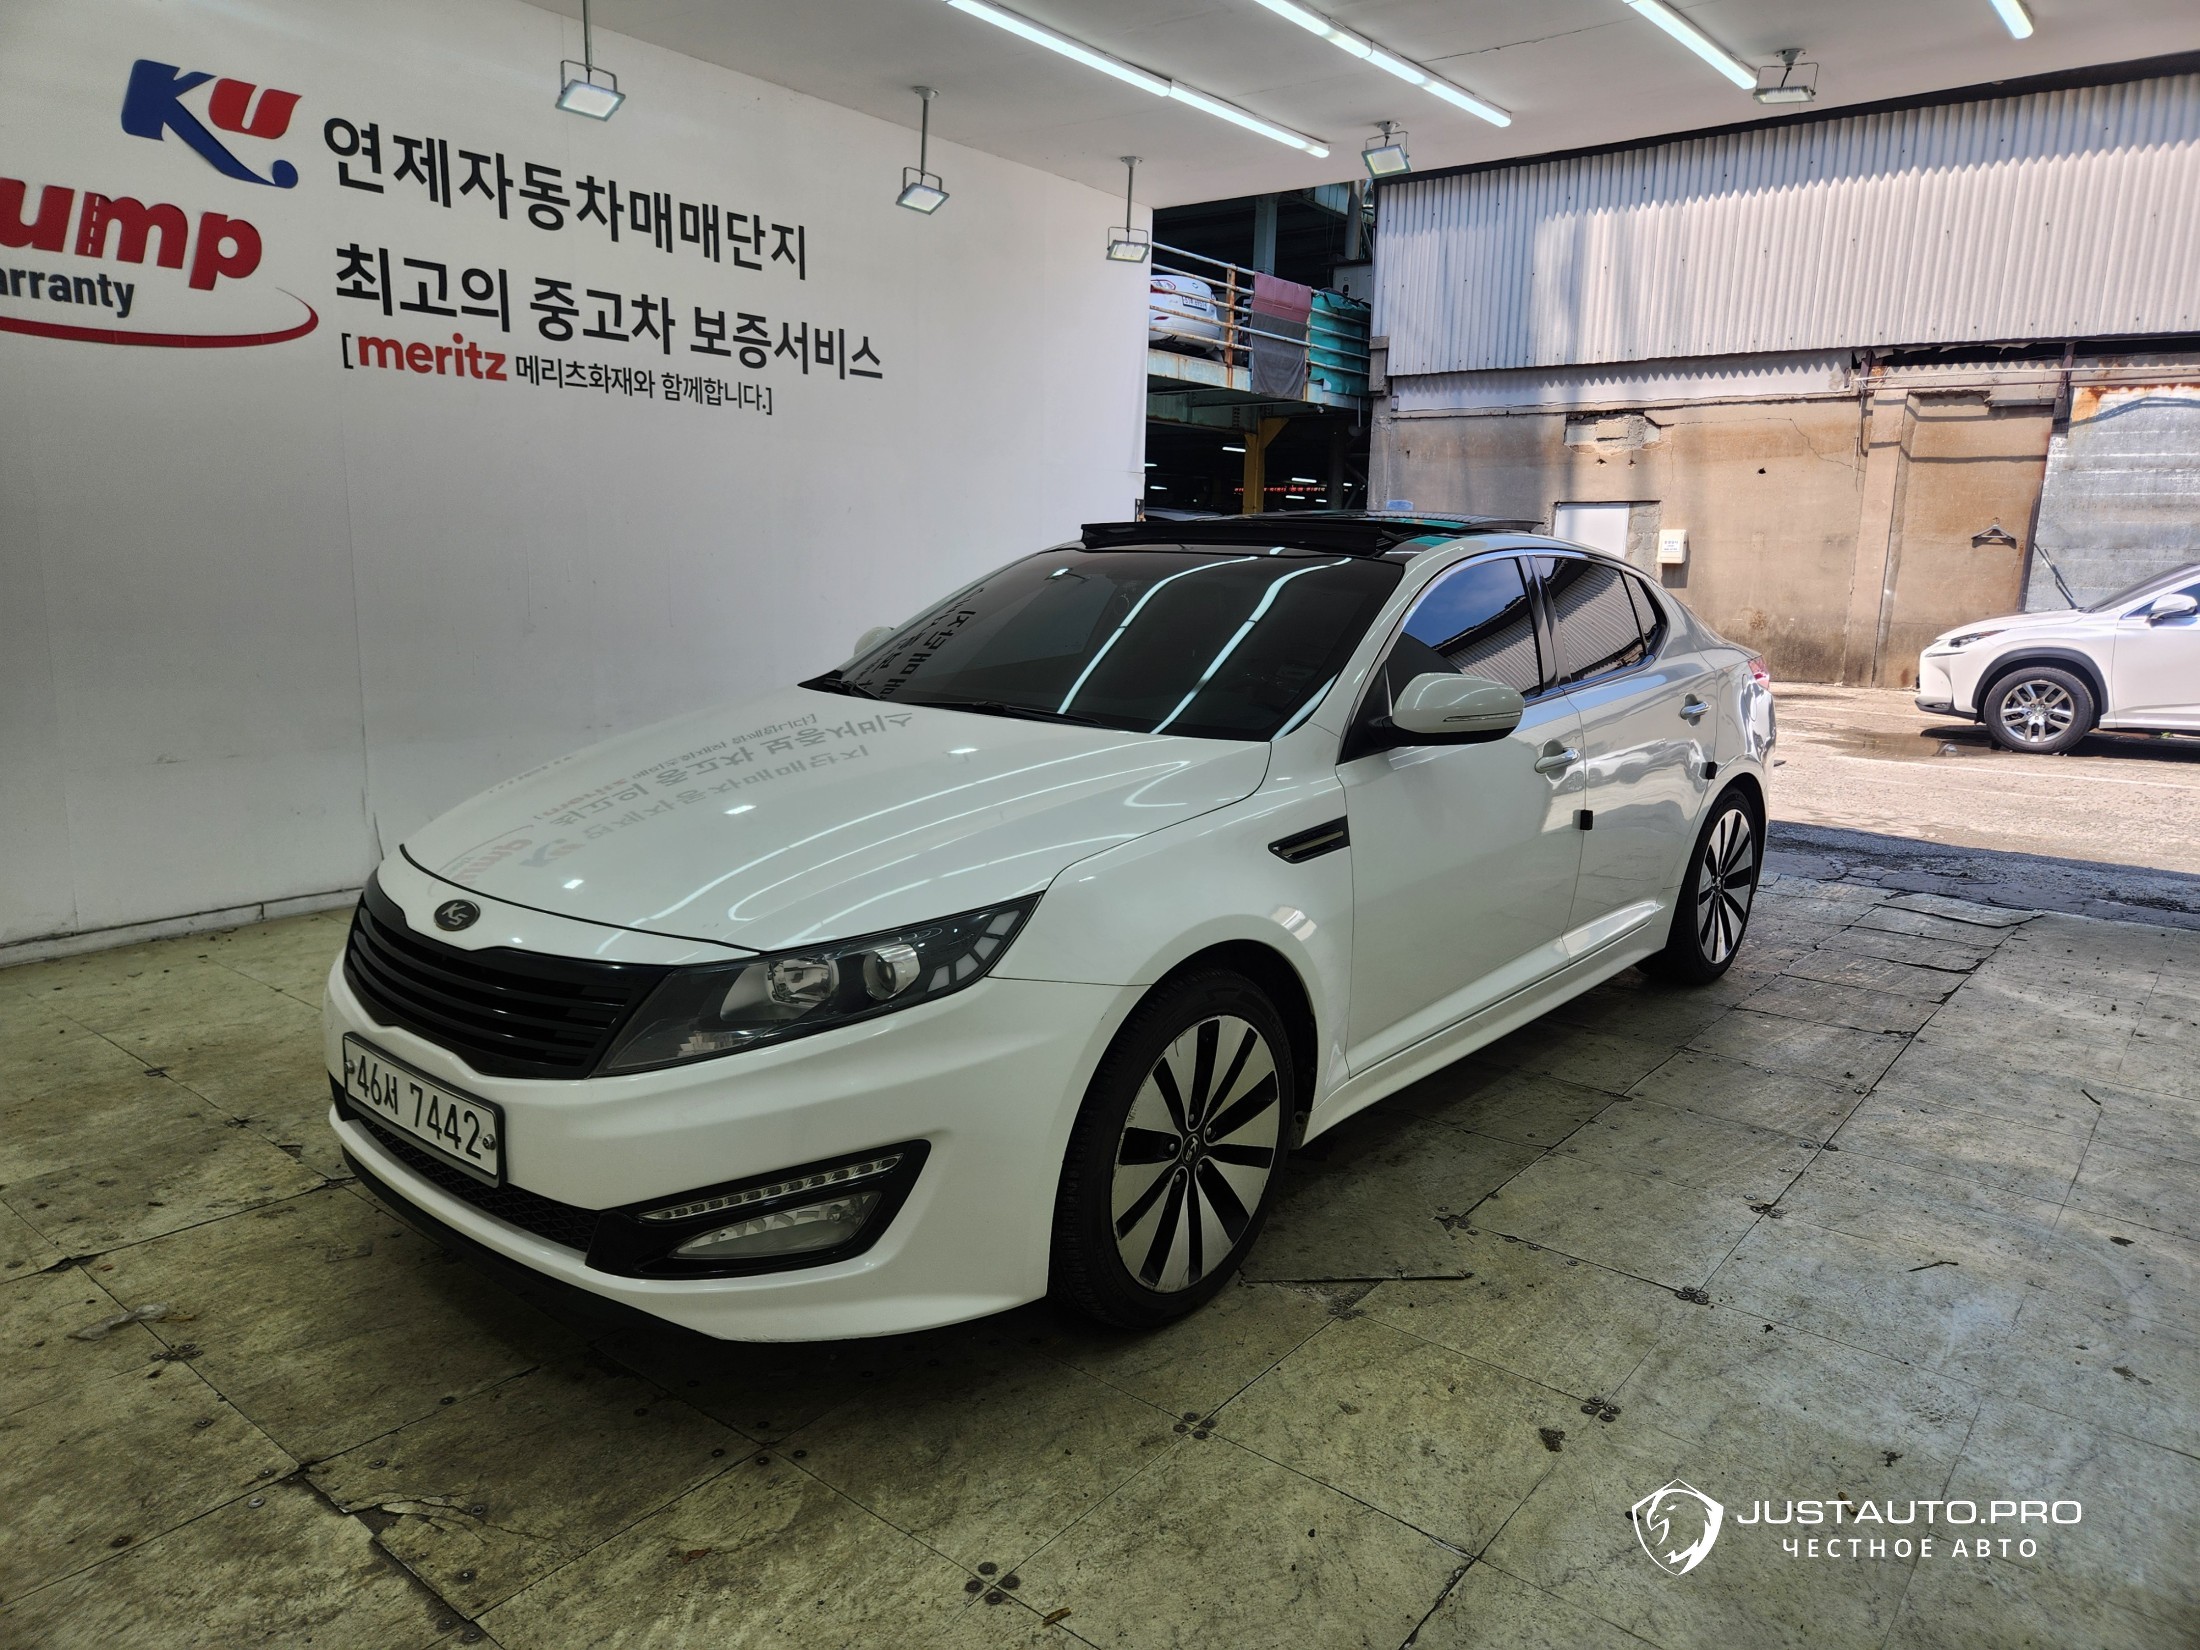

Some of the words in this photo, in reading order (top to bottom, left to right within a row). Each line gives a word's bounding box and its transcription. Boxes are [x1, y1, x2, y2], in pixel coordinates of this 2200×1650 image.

[324, 117, 806, 280] 연제자동차매매단지
[336, 242, 510, 332] 최고의
[529, 276, 675, 354] 중고차
[690, 306, 884, 380] 보증서비스
[516, 355, 655, 398] 메리츠화재와
[357, 1055, 398, 1115] 46서
[410, 1082, 481, 1160] 7442
